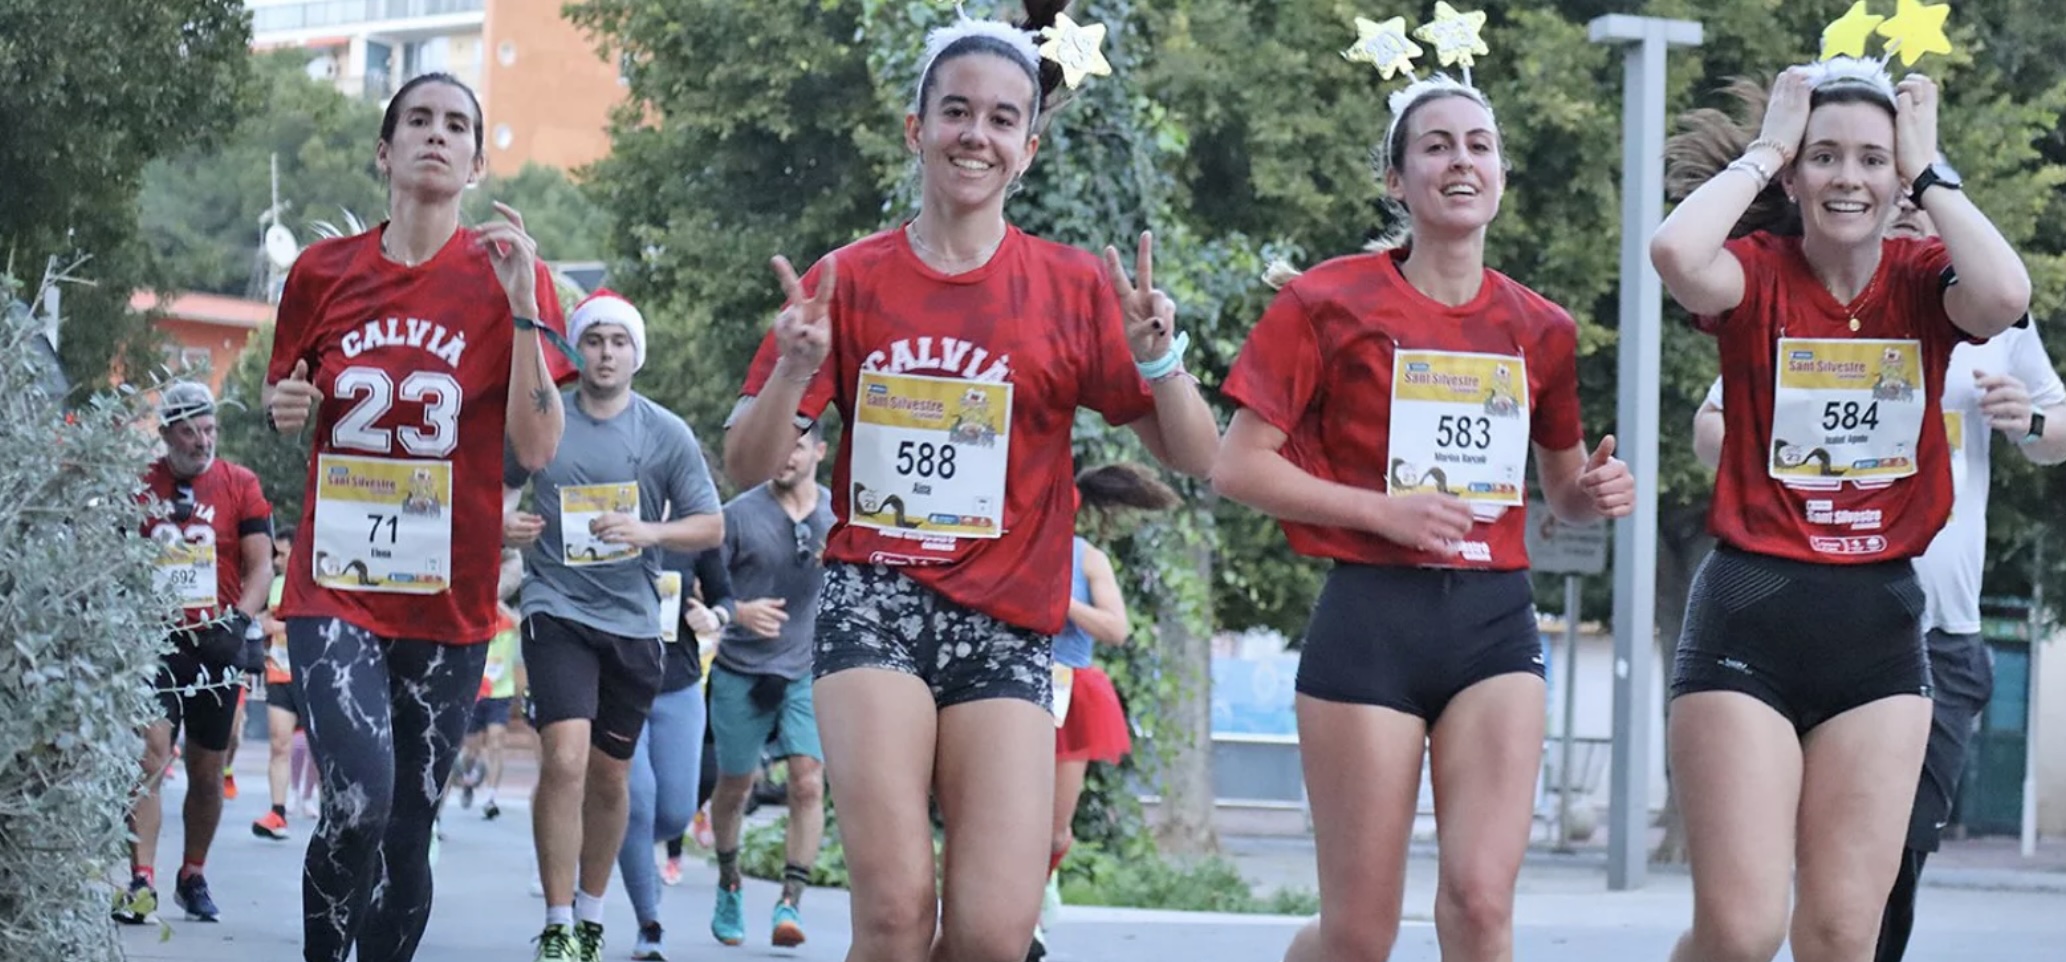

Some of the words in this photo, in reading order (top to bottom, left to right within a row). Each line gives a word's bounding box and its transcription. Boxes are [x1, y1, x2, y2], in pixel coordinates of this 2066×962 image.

[341, 317, 466, 368] CALVIÀ
[1404, 372, 1430, 385] Sant
[1432, 373, 1480, 388] Silvestre
[1789, 361, 1814, 373] Sant
[1817, 361, 1866, 374] Silvestre
[332, 365, 463, 458] 23
[890, 396, 943, 413] Silvestre
[1822, 400, 1879, 431] 584
[1436, 414, 1491, 450] 583
[895, 440, 957, 480] 588
[367, 514, 398, 544] 71
[170, 569, 197, 584] 692
